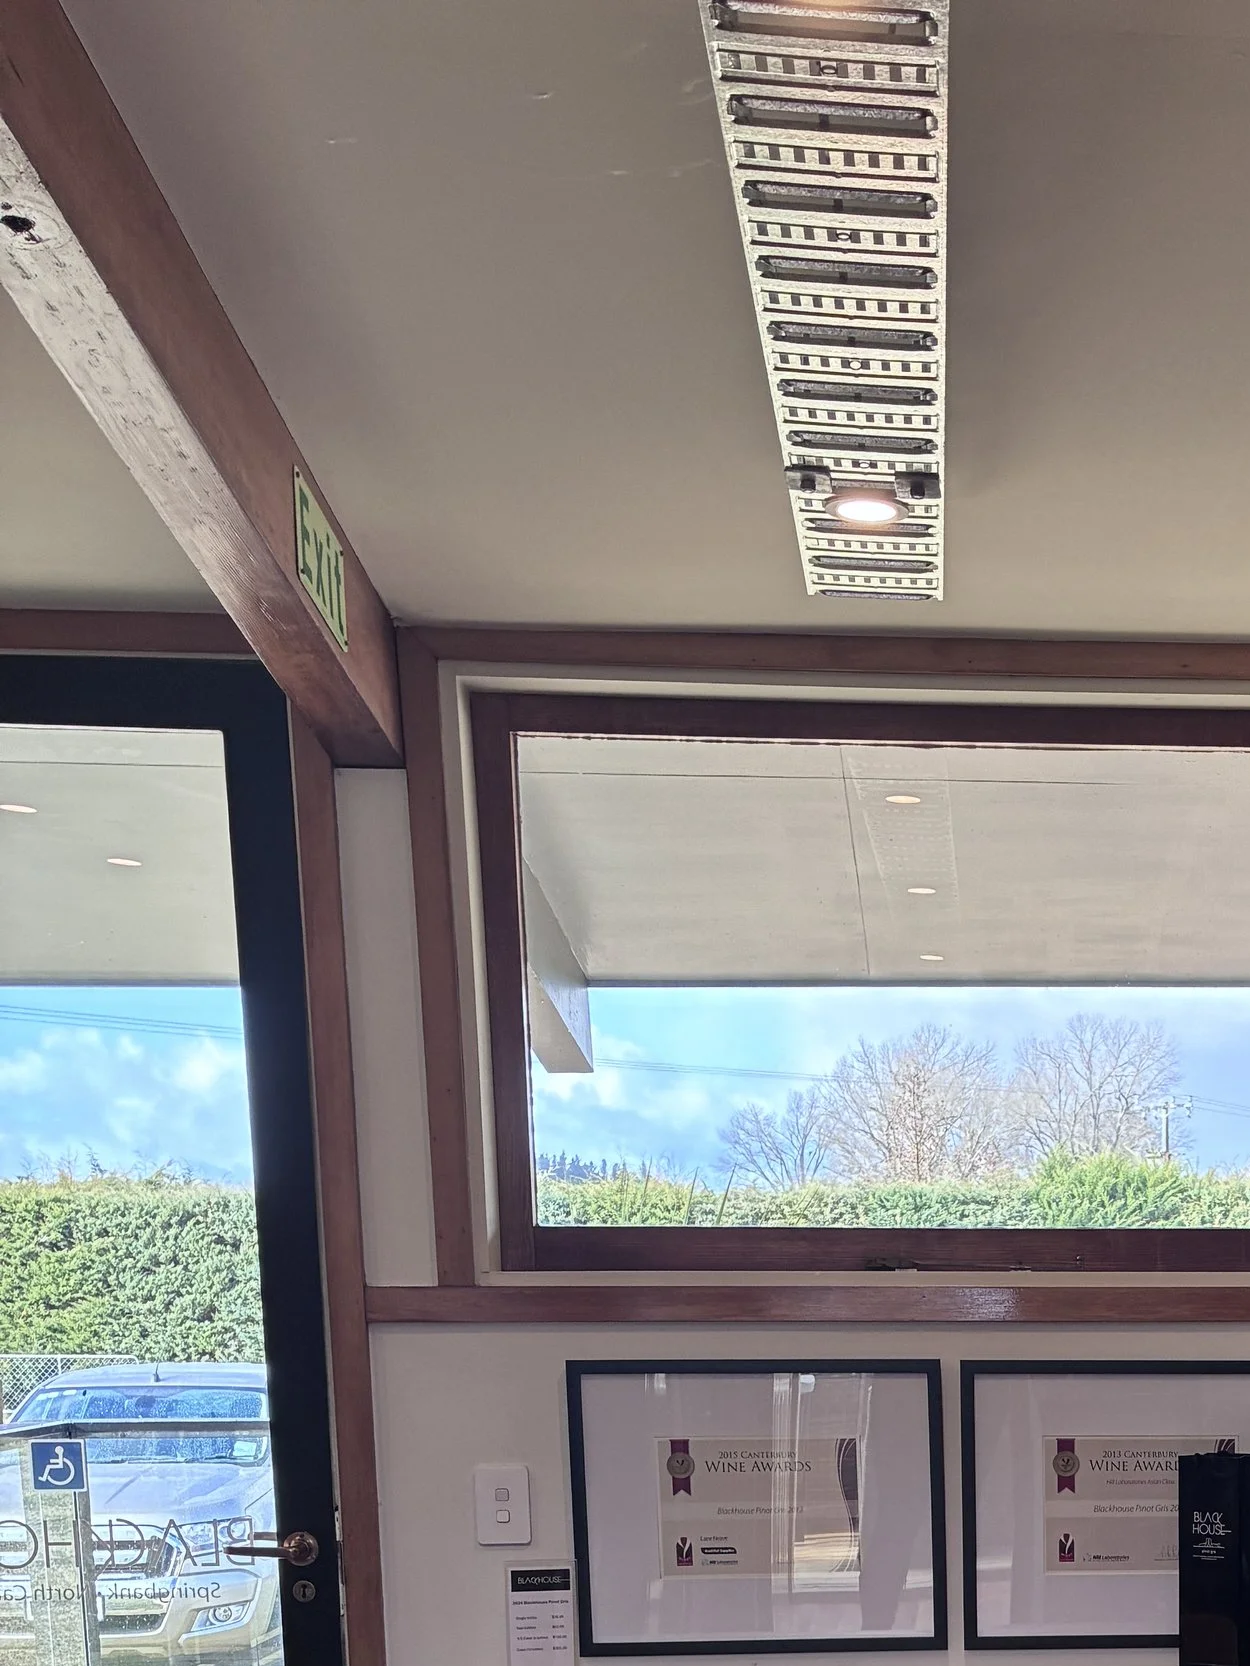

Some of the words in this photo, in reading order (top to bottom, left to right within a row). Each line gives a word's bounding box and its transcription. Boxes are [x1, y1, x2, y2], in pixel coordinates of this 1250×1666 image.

[298, 486, 346, 640] Exit
[718, 1450, 738, 1460] 2015
[1102, 1450, 1122, 1459] 2013
[1123, 1450, 1179, 1459] CANTERBURY
[705, 1460, 746, 1473] WINE
[751, 1460, 812, 1472] AWARDS
[1089, 1459, 1129, 1472] WINE
[1133, 1459, 1179, 1472] AWAR
[717, 1506, 755, 1516] Blackhouse
[1093, 1504, 1135, 1513] Blackhouse
[1135, 1504, 1154, 1513] Pinot
[1155, 1504, 1169, 1512] Gris
[1193, 1511, 1223, 1523] BLACK
[1192, 1523, 1232, 1536] HOUSE
